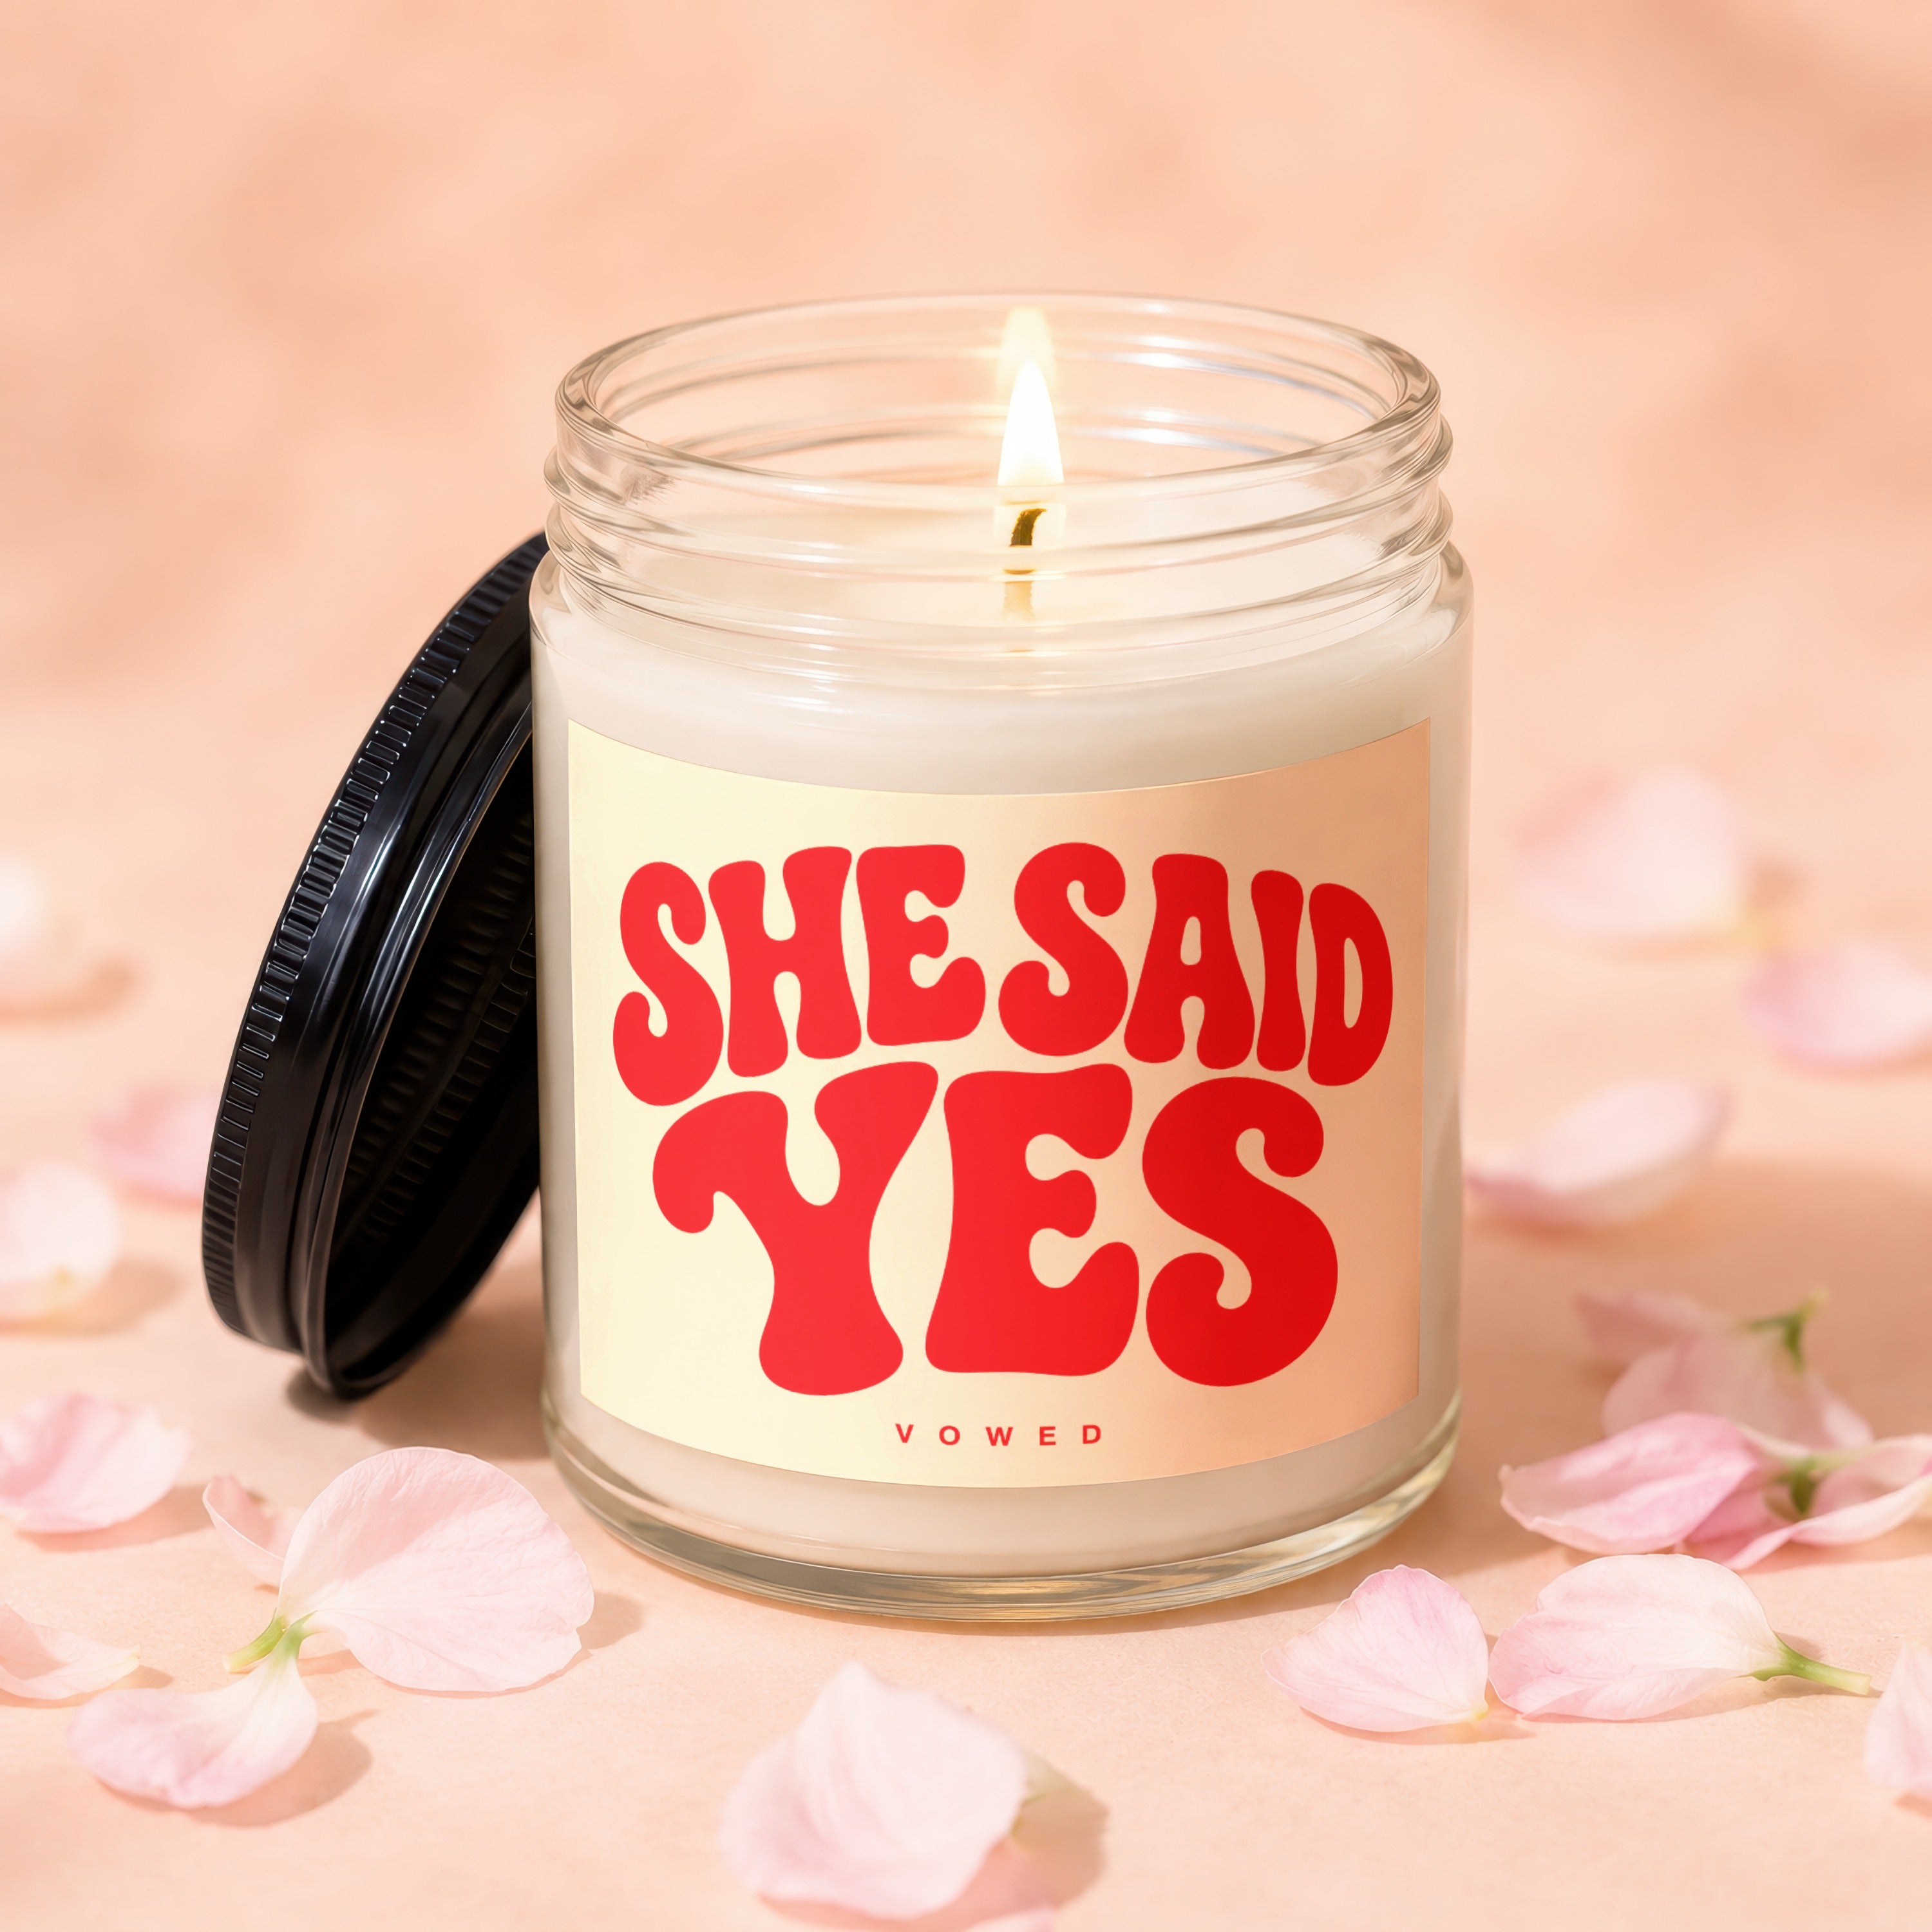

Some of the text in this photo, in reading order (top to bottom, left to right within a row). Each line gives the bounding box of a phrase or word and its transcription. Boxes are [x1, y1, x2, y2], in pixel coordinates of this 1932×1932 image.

[612, 842, 1394, 1106] SHE SAID
[652, 1061, 1338, 1396] YES
[895, 1423, 1104, 1447] VOWED
